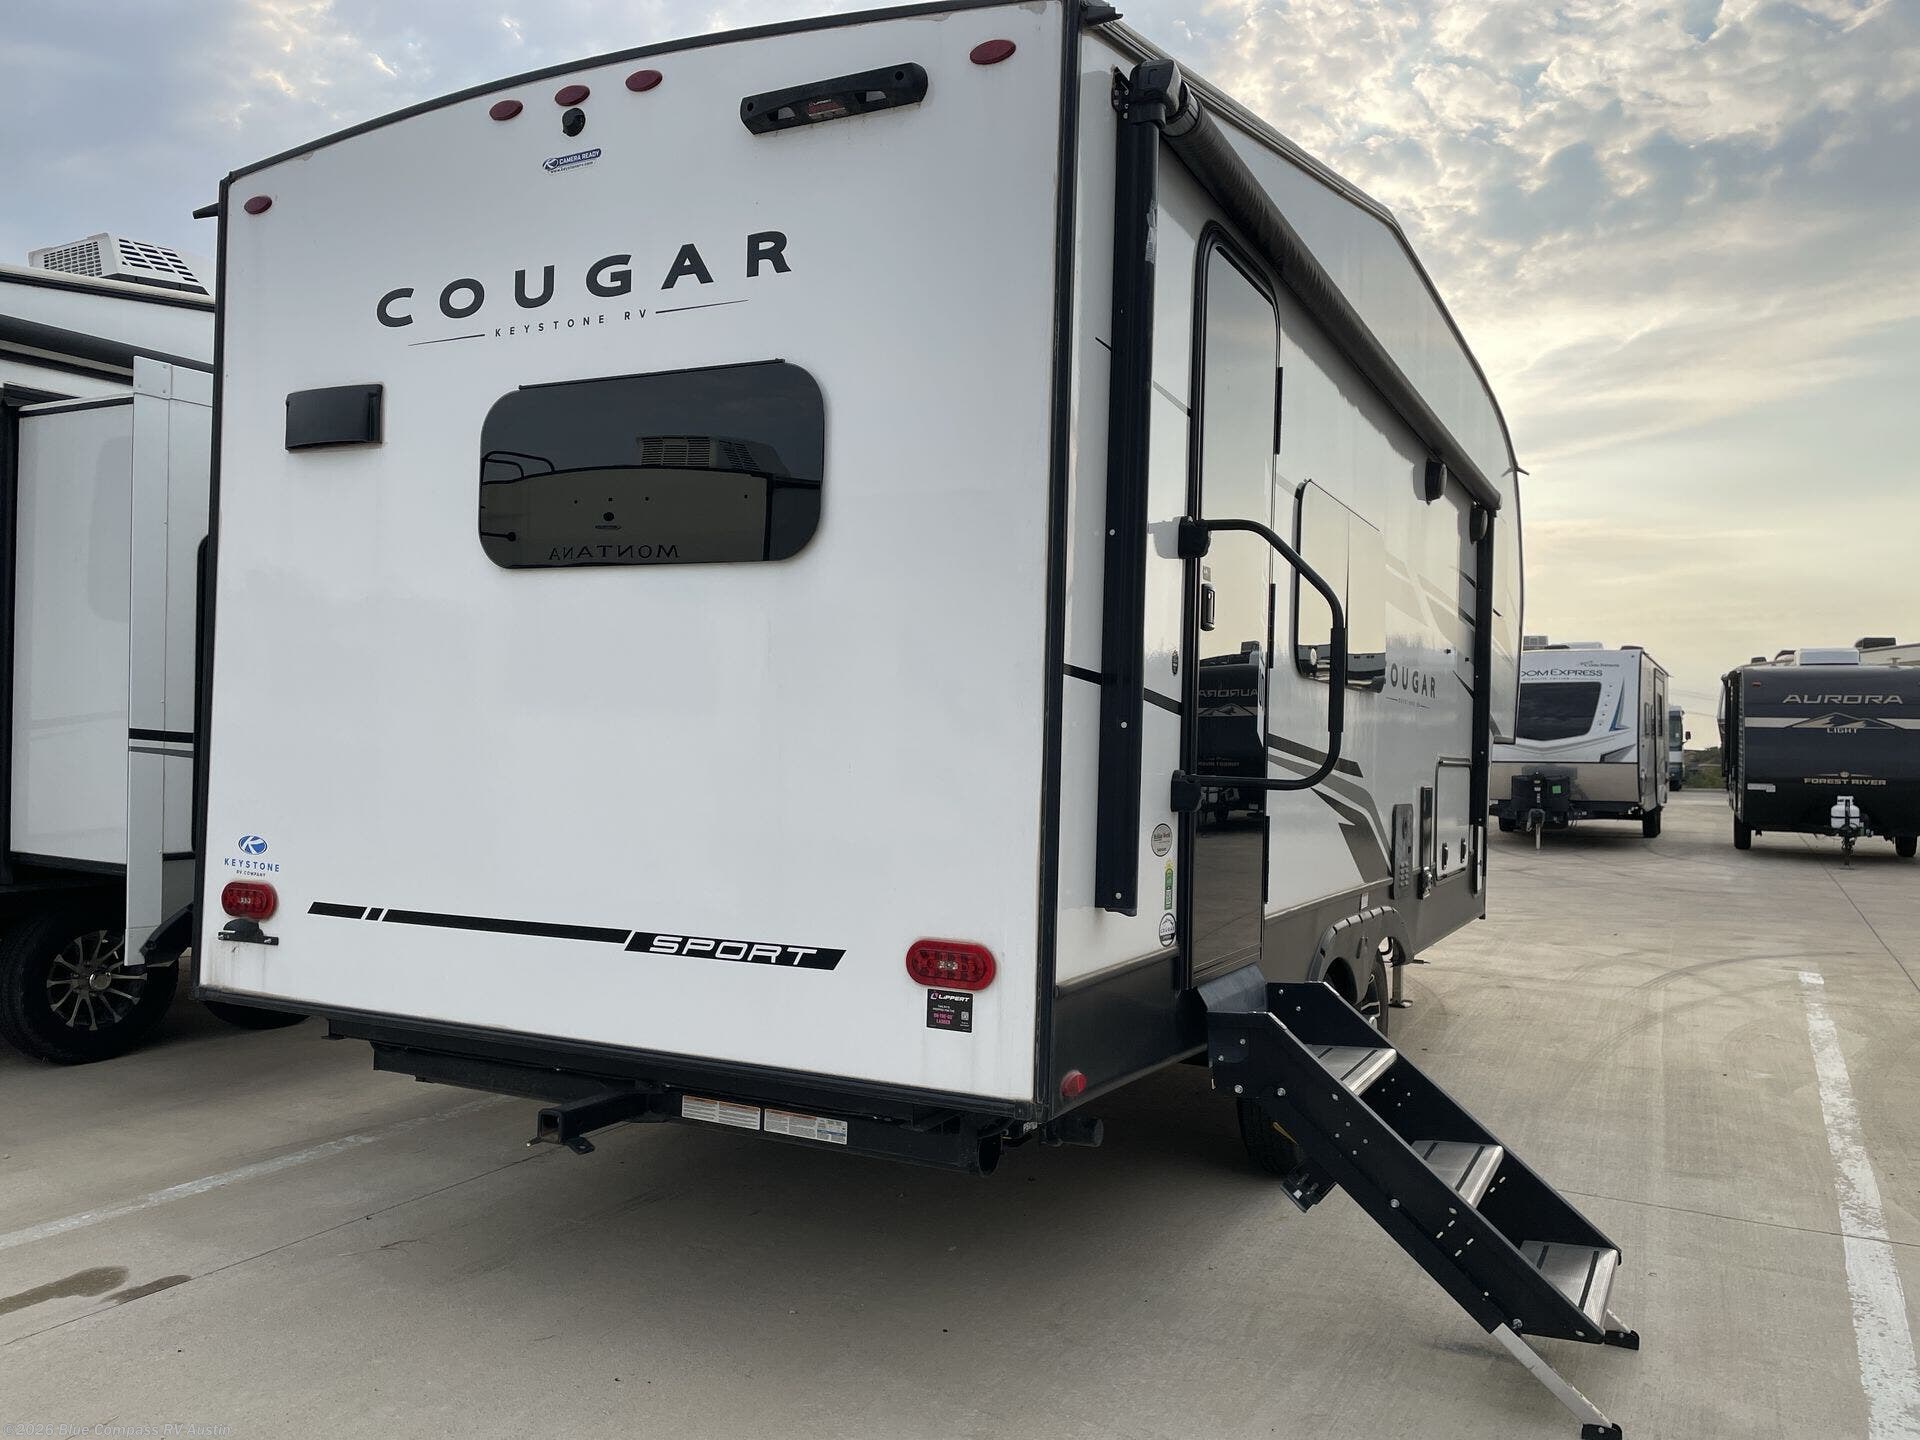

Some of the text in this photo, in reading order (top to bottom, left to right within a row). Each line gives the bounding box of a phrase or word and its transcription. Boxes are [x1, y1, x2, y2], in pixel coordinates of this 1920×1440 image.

[559, 150, 600, 165] CAMERA READY
[376, 230, 792, 328] COUGAR
[495, 309, 648, 337] KEYSTONE RV
[1550, 668, 1603, 677] EXPRESS
[1390, 663, 1436, 699] OUGAR
[1782, 694, 1904, 705] AURORA
[1804, 777, 1887, 786] FOREST RIVER
[224, 858, 280, 873] KEYSTONE
[649, 935, 818, 966] SPORT
[938, 994, 970, 1002] LIPPERT
